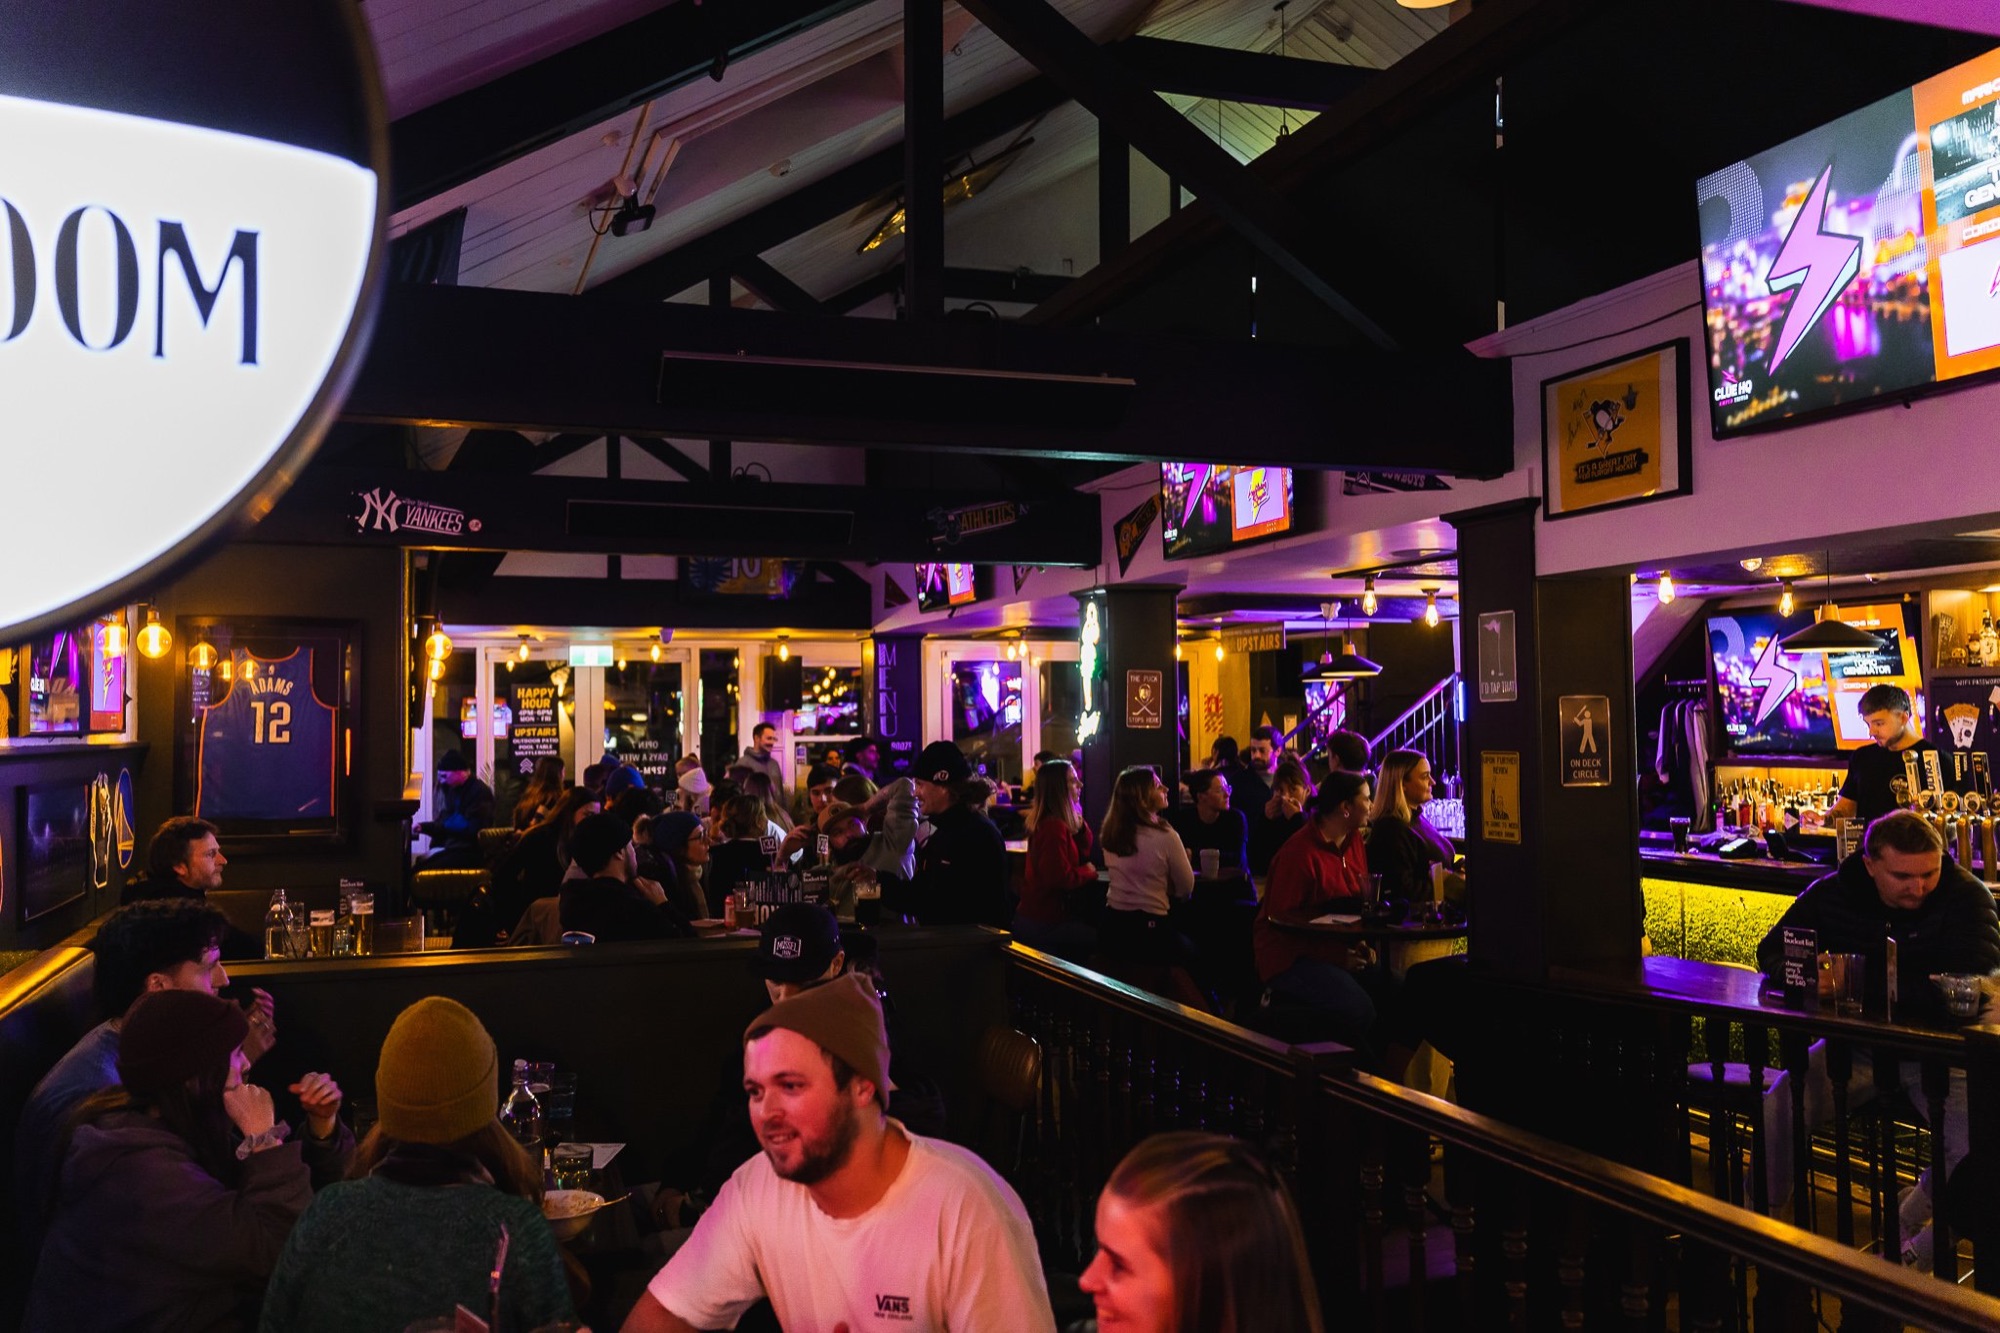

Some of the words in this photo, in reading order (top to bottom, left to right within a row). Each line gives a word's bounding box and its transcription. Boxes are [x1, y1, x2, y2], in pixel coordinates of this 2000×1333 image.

[1715, 383, 1737, 401] CLUE
[1738, 380, 1752, 395] HQ
[404, 504, 465, 533] YANKEES
[961, 502, 1016, 532] ATHLETICS
[1236, 633, 1280, 652] UPSTAIRS
[1843, 664, 1892, 676] GENERATOR
[1130, 674, 1141, 683] THE
[250, 677, 294, 696] ADAMS
[517, 687, 555, 699] HAPPY
[878, 642, 898, 737] MENU
[1490, 681, 1501, 694] TAP
[1502, 680, 1516, 693] THAT
[521, 698, 551, 709] HOUR
[250, 701, 292, 744] 12
[514, 727, 557, 737] UPSTAIRS
[1570, 759, 1581, 768] ON
[1582, 758, 1602, 768] DECK
[1573, 769, 1600, 779] CIRCLE
[1924, 759, 1936, 791] ULTRA
[1784, 930, 1794, 938] the
[1784, 936, 1805, 945] bucket
[1805, 939, 1814, 948] list
[876, 1294, 909, 1313] VANS
